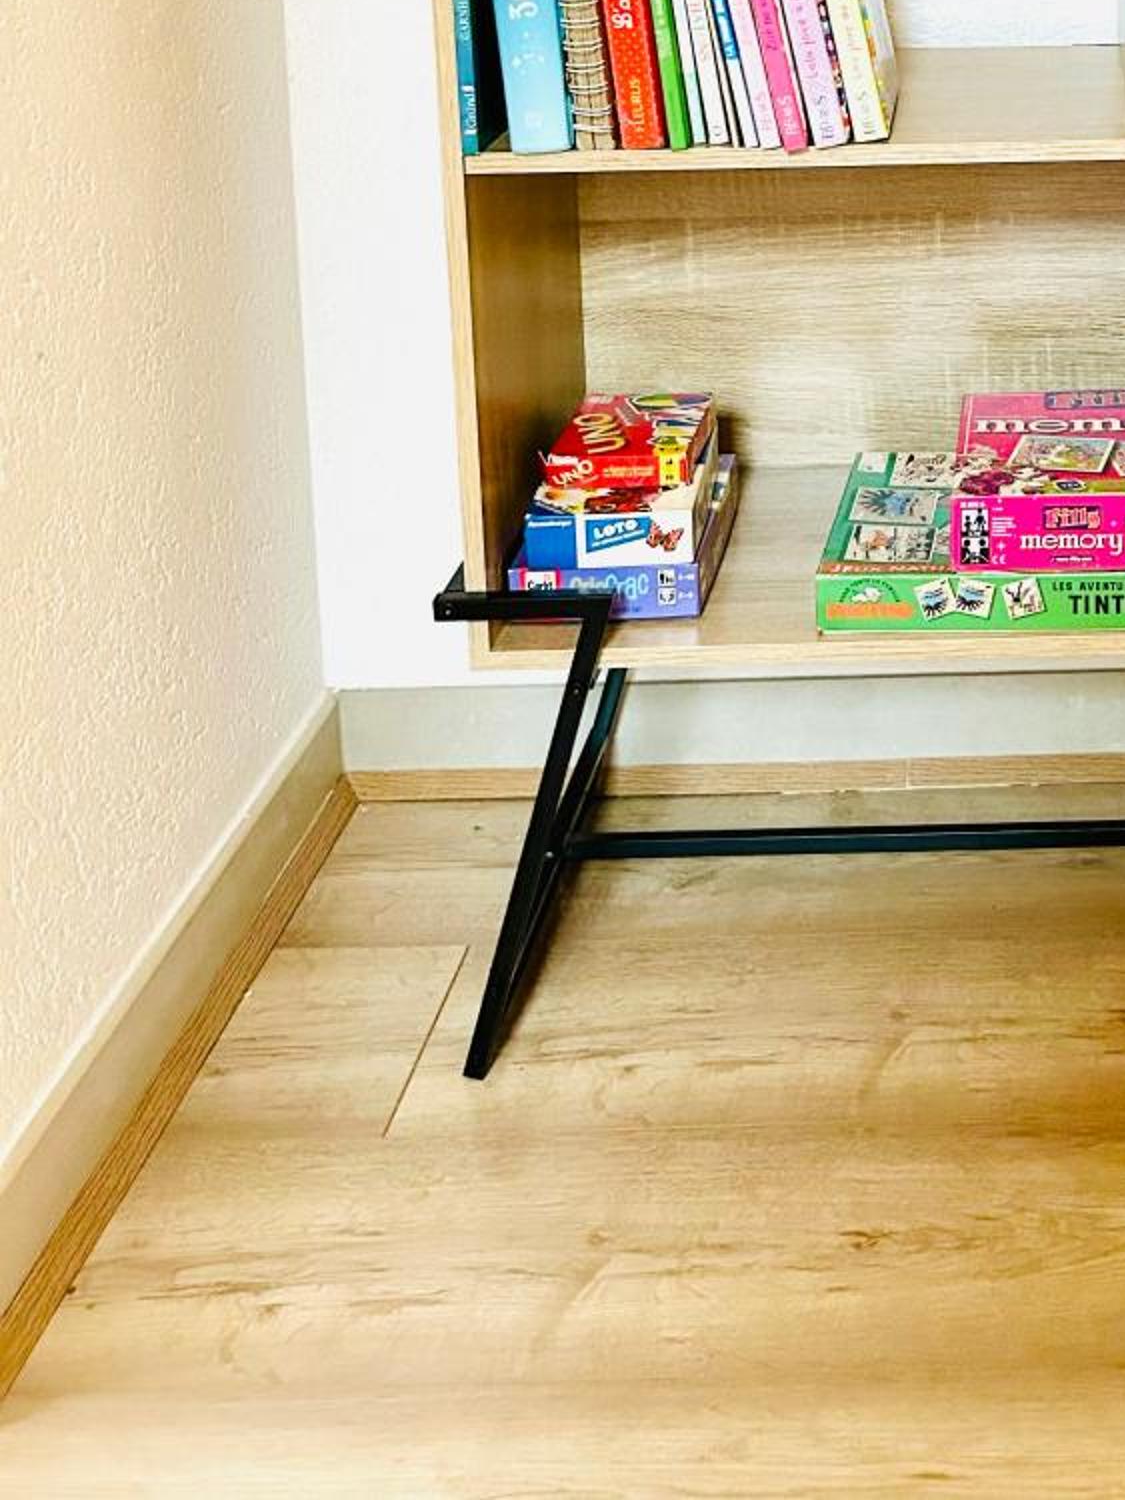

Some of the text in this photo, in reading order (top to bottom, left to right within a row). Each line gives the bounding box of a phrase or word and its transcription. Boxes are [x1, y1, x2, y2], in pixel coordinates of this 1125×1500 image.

[573, 413, 626, 454] UNO
[551, 459, 593, 486] UNO
[593, 519, 638, 540] LOTO
[1019, 533, 1123, 557] memory
[1052, 581, 1073, 592] LES
